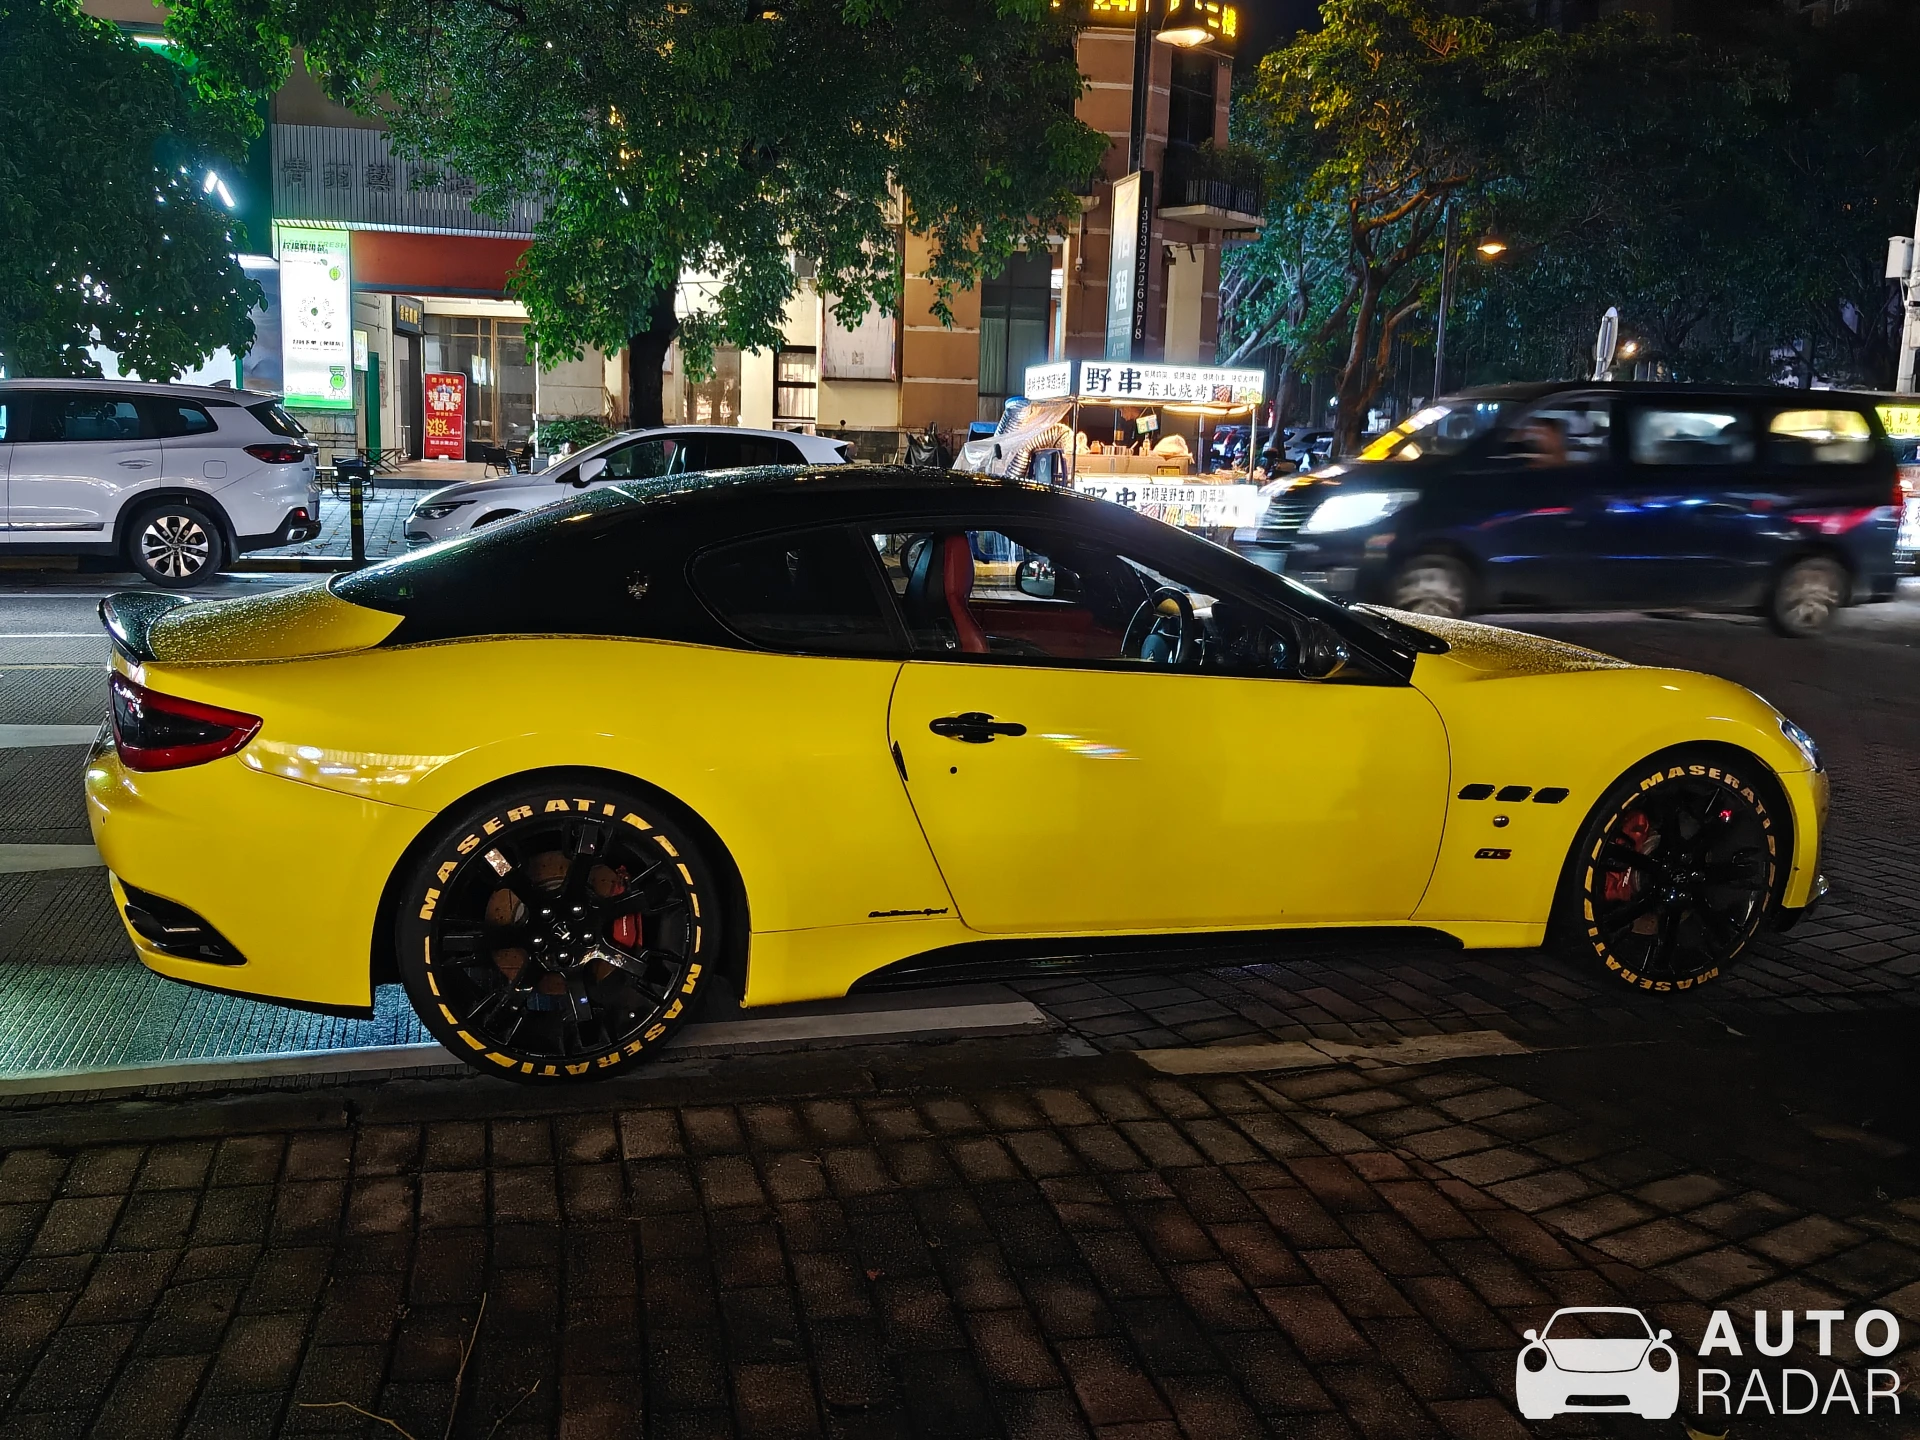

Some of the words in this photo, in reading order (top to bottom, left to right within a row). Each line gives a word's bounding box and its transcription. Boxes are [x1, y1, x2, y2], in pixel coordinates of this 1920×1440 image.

[1135, 197, 1148, 339] 13532226878
[1086, 367, 1143, 394] 野串
[1148, 381, 1208, 399] 东北烧烤
[1142, 487, 1195, 502] 环境是野生的
[1640, 765, 1771, 829] MASERATI
[419, 798, 616, 921] MASERATI
[1588, 927, 1719, 992] MASERATI
[521, 964, 702, 1077] MASERATI
